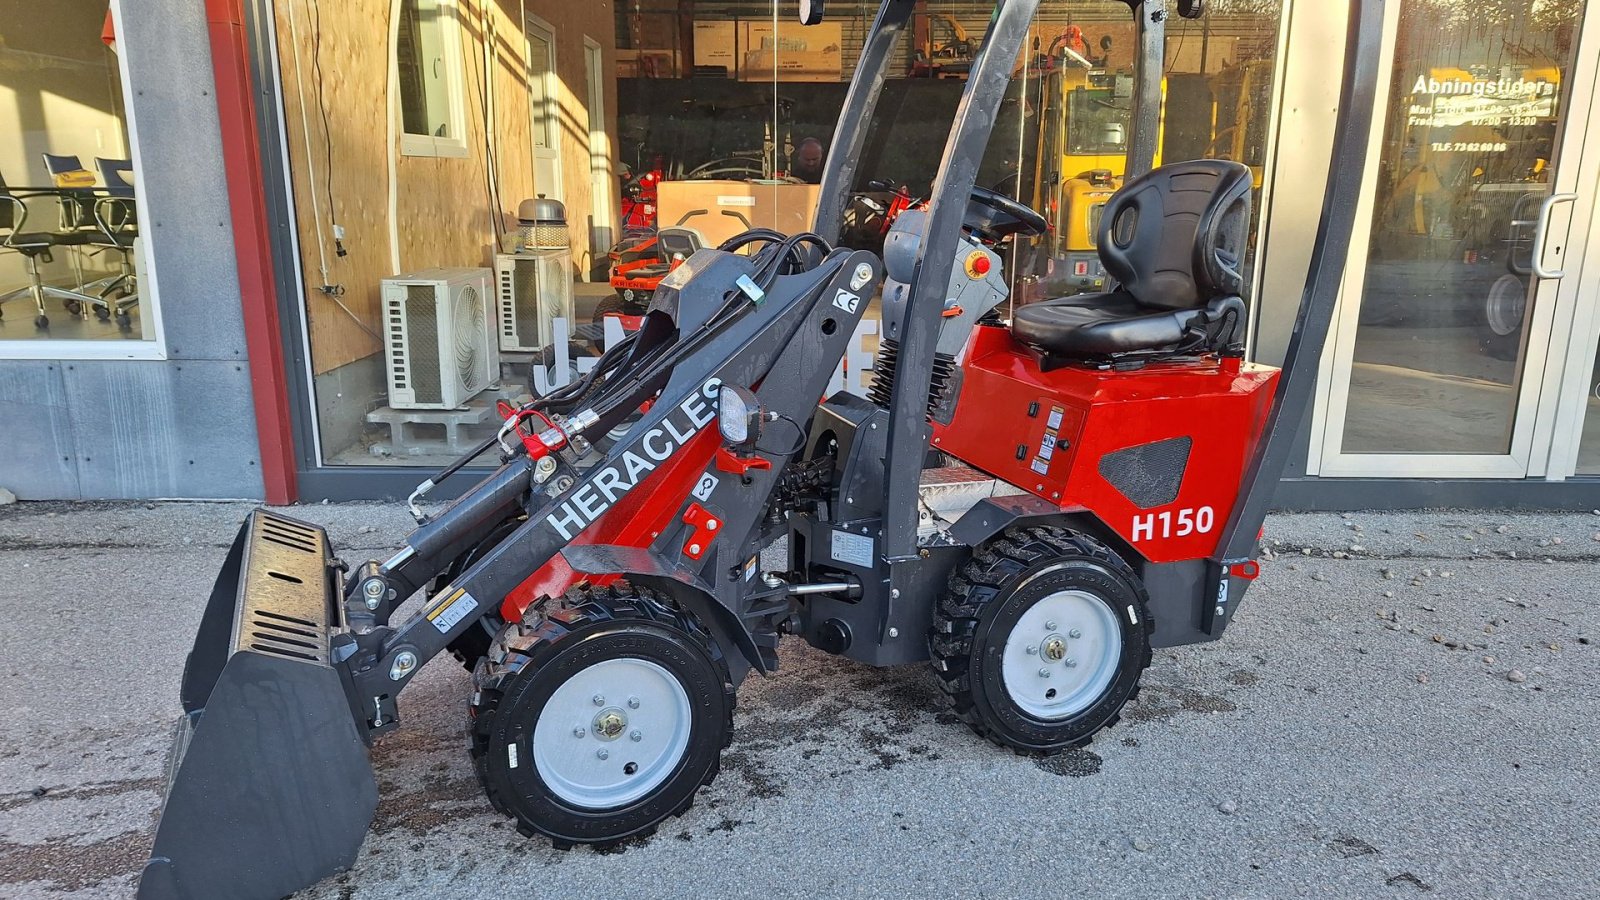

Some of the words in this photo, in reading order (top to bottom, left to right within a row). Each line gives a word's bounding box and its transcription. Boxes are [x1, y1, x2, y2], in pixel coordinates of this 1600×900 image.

[1409, 104, 1432, 115] Man
[1472, 116, 1500, 126] 07:00
[1508, 116, 1537, 126] 13:00
[1131, 505, 1215, 542] H150
